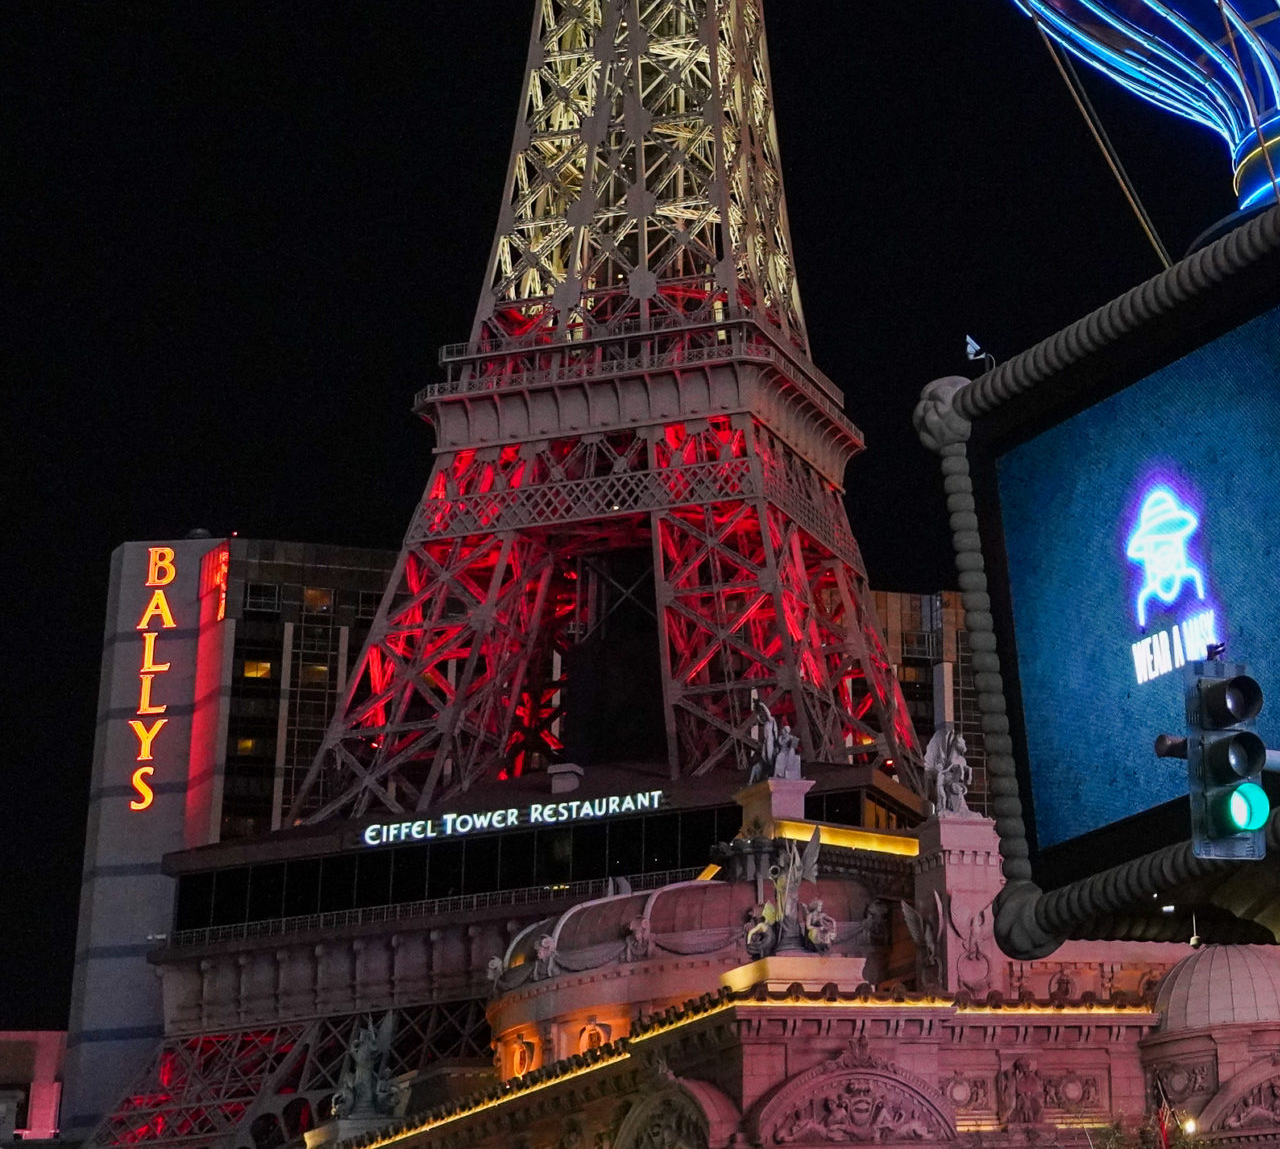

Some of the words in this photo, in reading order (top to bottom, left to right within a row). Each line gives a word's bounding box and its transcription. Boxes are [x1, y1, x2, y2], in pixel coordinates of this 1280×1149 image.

[128, 547, 177, 810] BALLYS
[1131, 630, 1173, 684] WEAR
[1172, 624, 1186, 669] A
[364, 820, 437, 845] EIFFEL
[442, 807, 519, 835] TOWER
[529, 790, 664, 824] RESTAURANT
